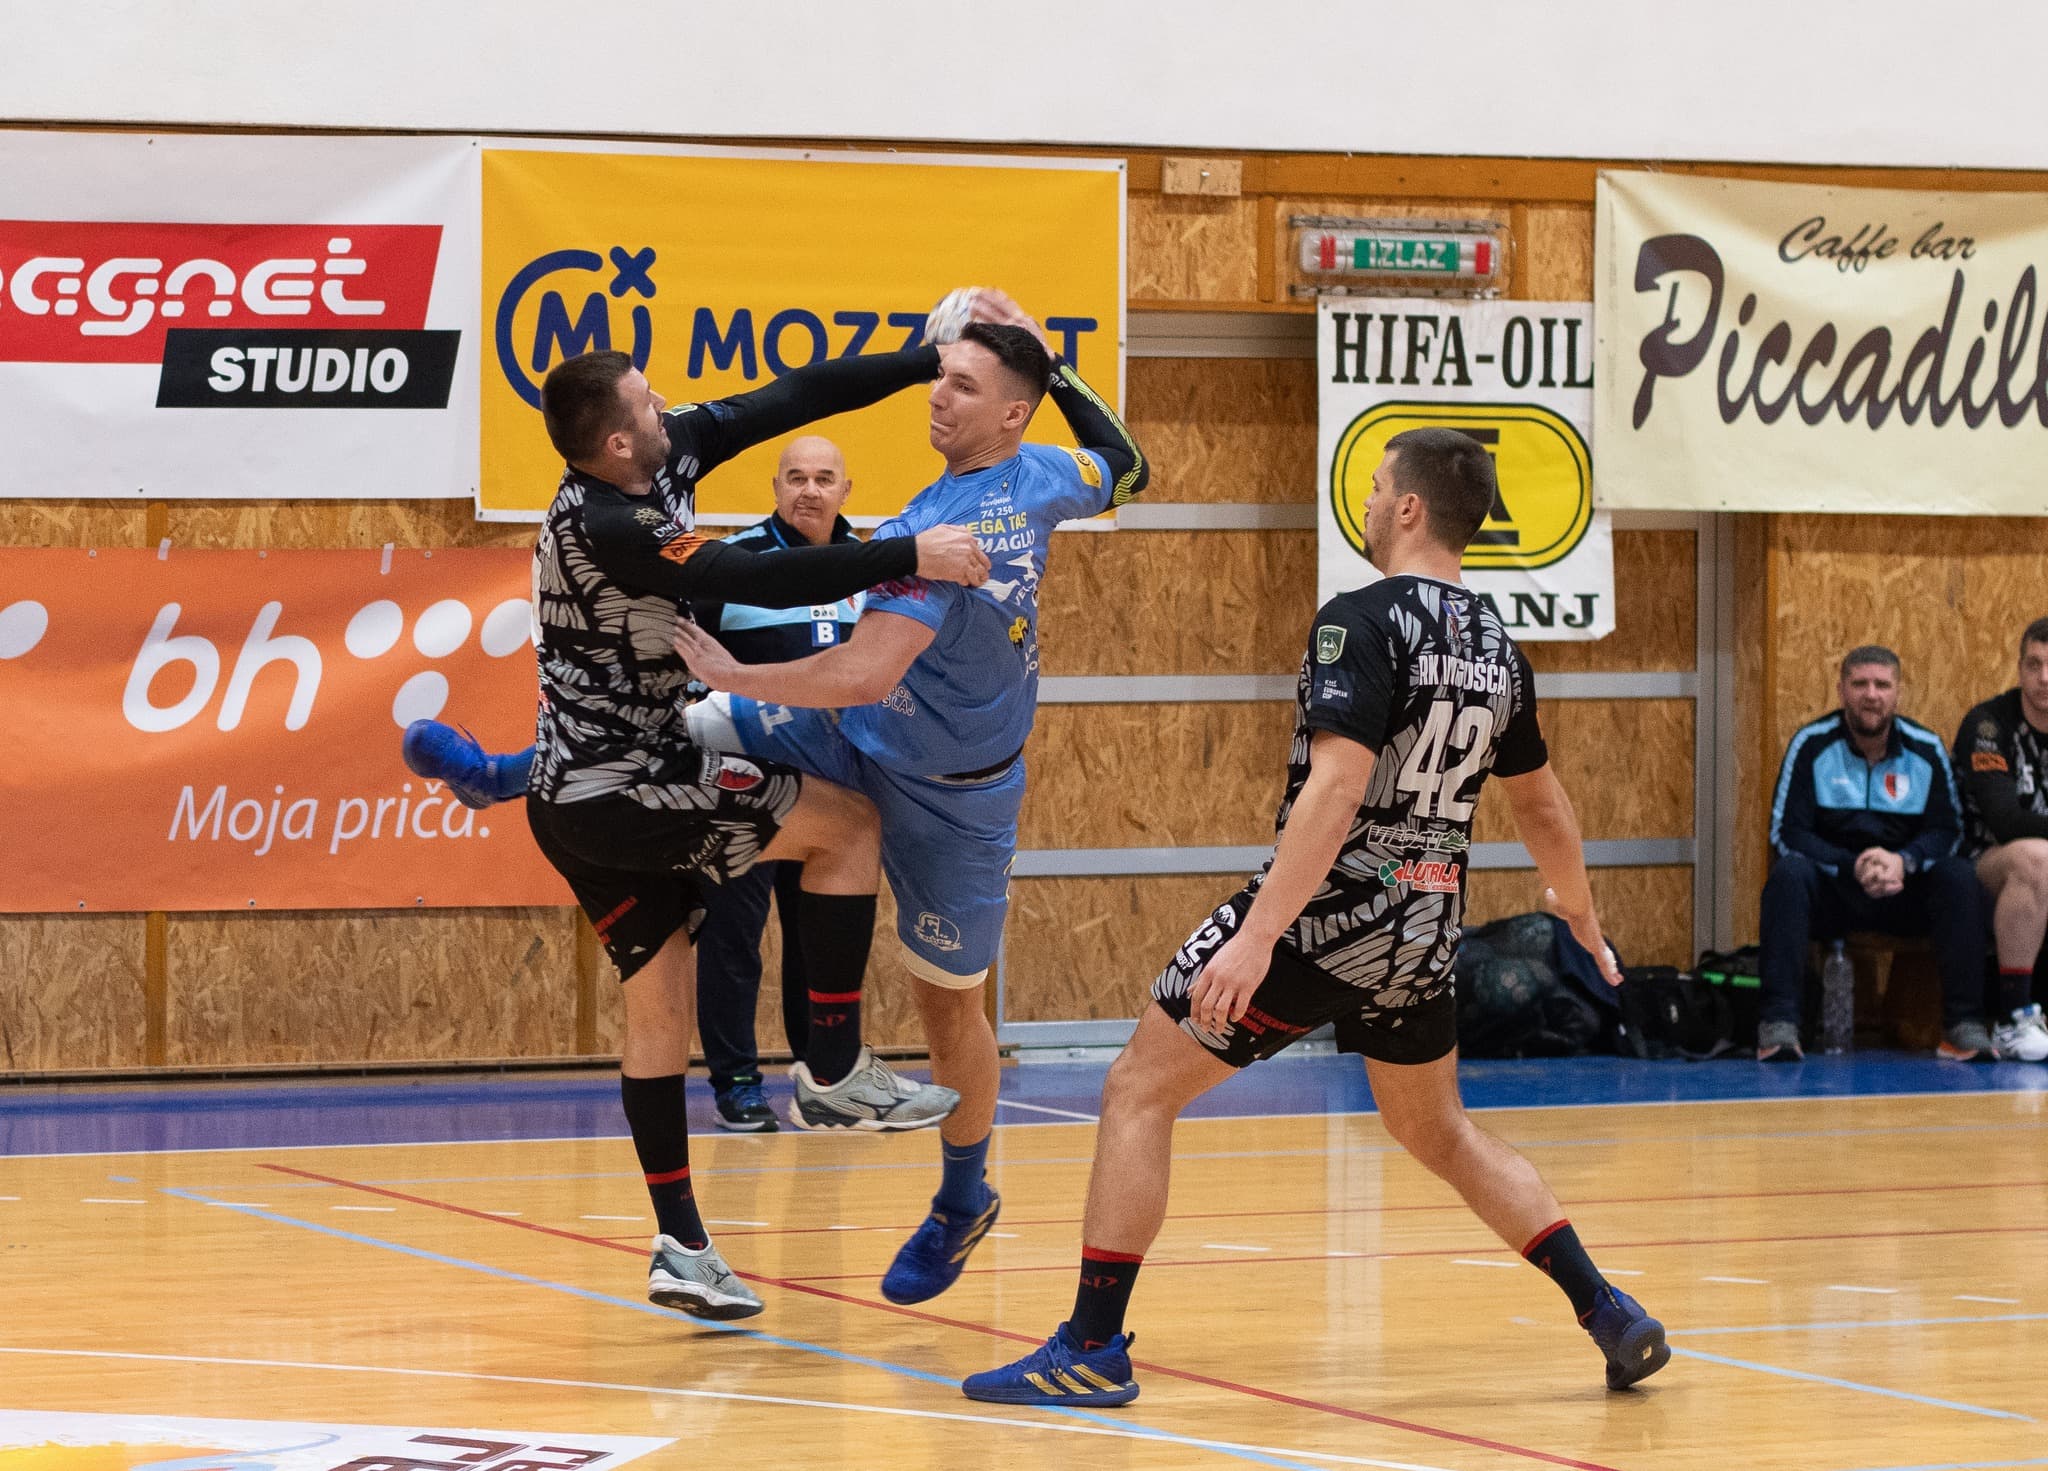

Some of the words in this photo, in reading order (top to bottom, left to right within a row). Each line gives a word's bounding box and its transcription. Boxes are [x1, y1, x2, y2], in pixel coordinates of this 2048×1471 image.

[1368, 238, 1447, 270] IZLAZ
[1778, 216, 1898, 273] Caffe
[1909, 221, 1977, 261] bar
[0, 237, 386, 337] agnet
[207, 346, 410, 393] STUDIO
[686, 306, 1099, 381] MOZZT
[1331, 311, 1595, 389] HIFA-OIL
[966, 517, 1006, 535] EGA
[1007, 511, 1027, 532] TAS
[996, 504, 1014, 517] 250
[816, 621, 835, 644] B
[121, 600, 323, 733] bh
[1418, 654, 1440, 686] RK
[1396, 699, 1495, 823] 42
[167, 784, 316, 856] Moja
[328, 782, 491, 855] priča.
